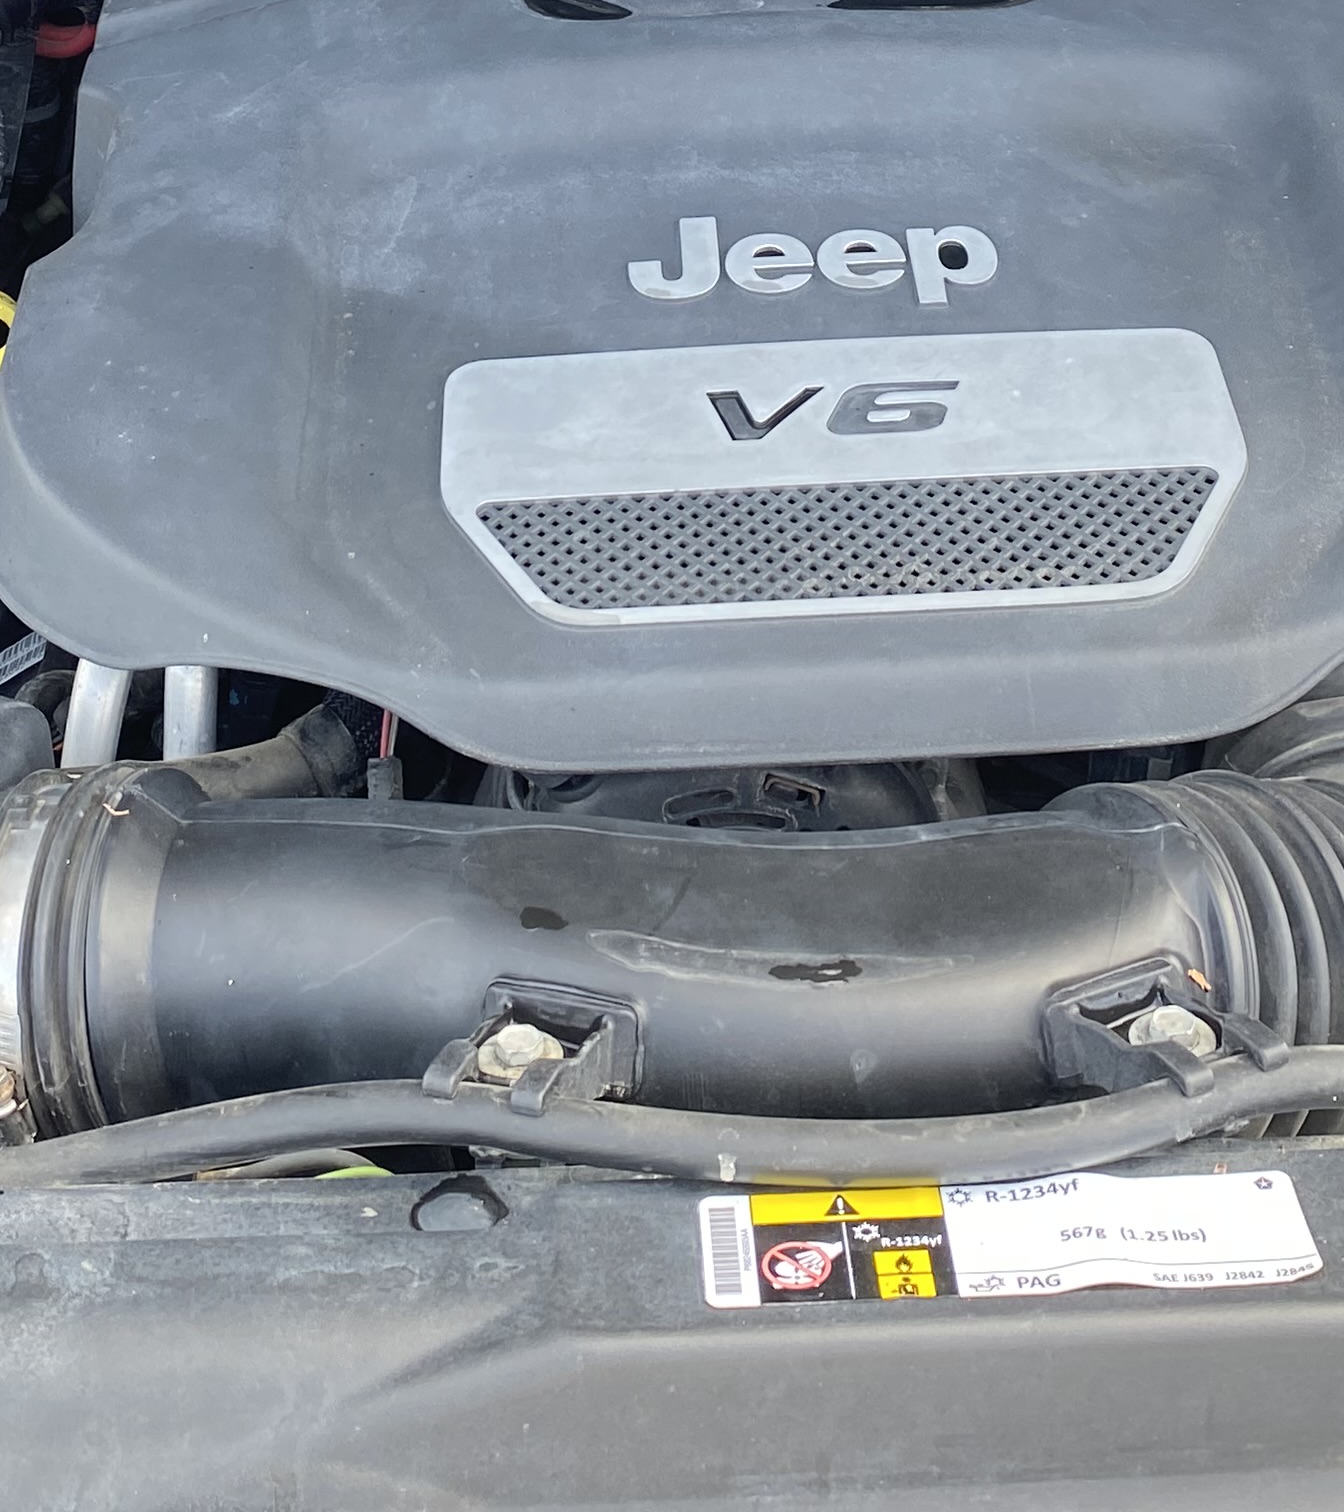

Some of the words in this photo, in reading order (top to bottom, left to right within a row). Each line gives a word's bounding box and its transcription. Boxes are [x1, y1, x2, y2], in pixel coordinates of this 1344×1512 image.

[627, 216, 999, 308] Jeep
[704, 378, 961, 442] V6
[984, 1178, 1081, 1205] R-1234yf
[879, 1232, 943, 1249] R-1234yf
[1059, 1224, 1107, 1244] 567g
[1119, 1226, 1168, 1245] (1.25
[1172, 1226, 1208, 1245] lbs)
[1016, 1272, 1063, 1290] PAG
[1153, 1270, 1181, 1284] SAE
[1183, 1270, 1215, 1285] J639
[1225, 1269, 1265, 1282] J2842
